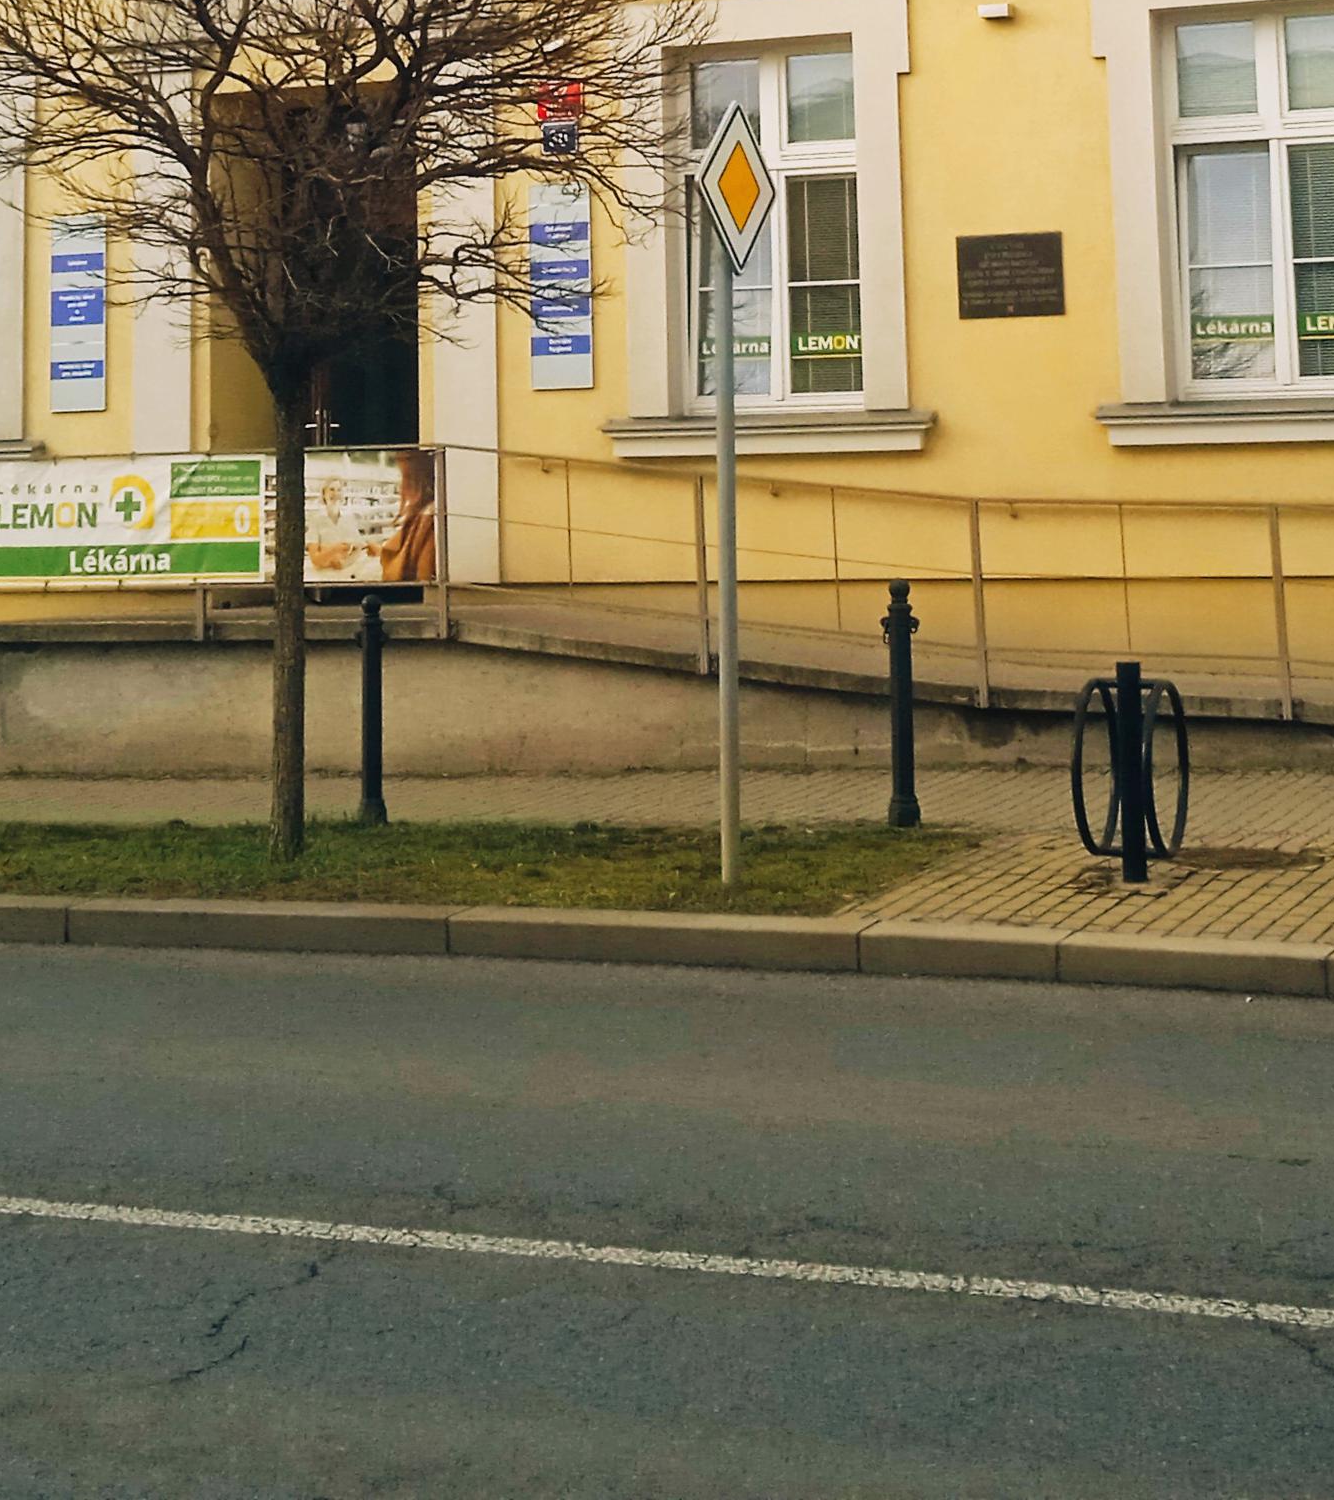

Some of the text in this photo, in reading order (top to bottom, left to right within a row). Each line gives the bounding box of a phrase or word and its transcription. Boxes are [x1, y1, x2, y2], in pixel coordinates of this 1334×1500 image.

[1195, 318, 1272, 336] Lékárna
[797, 334, 859, 351] LEMON
[68, 547, 172, 574] Lékárna
